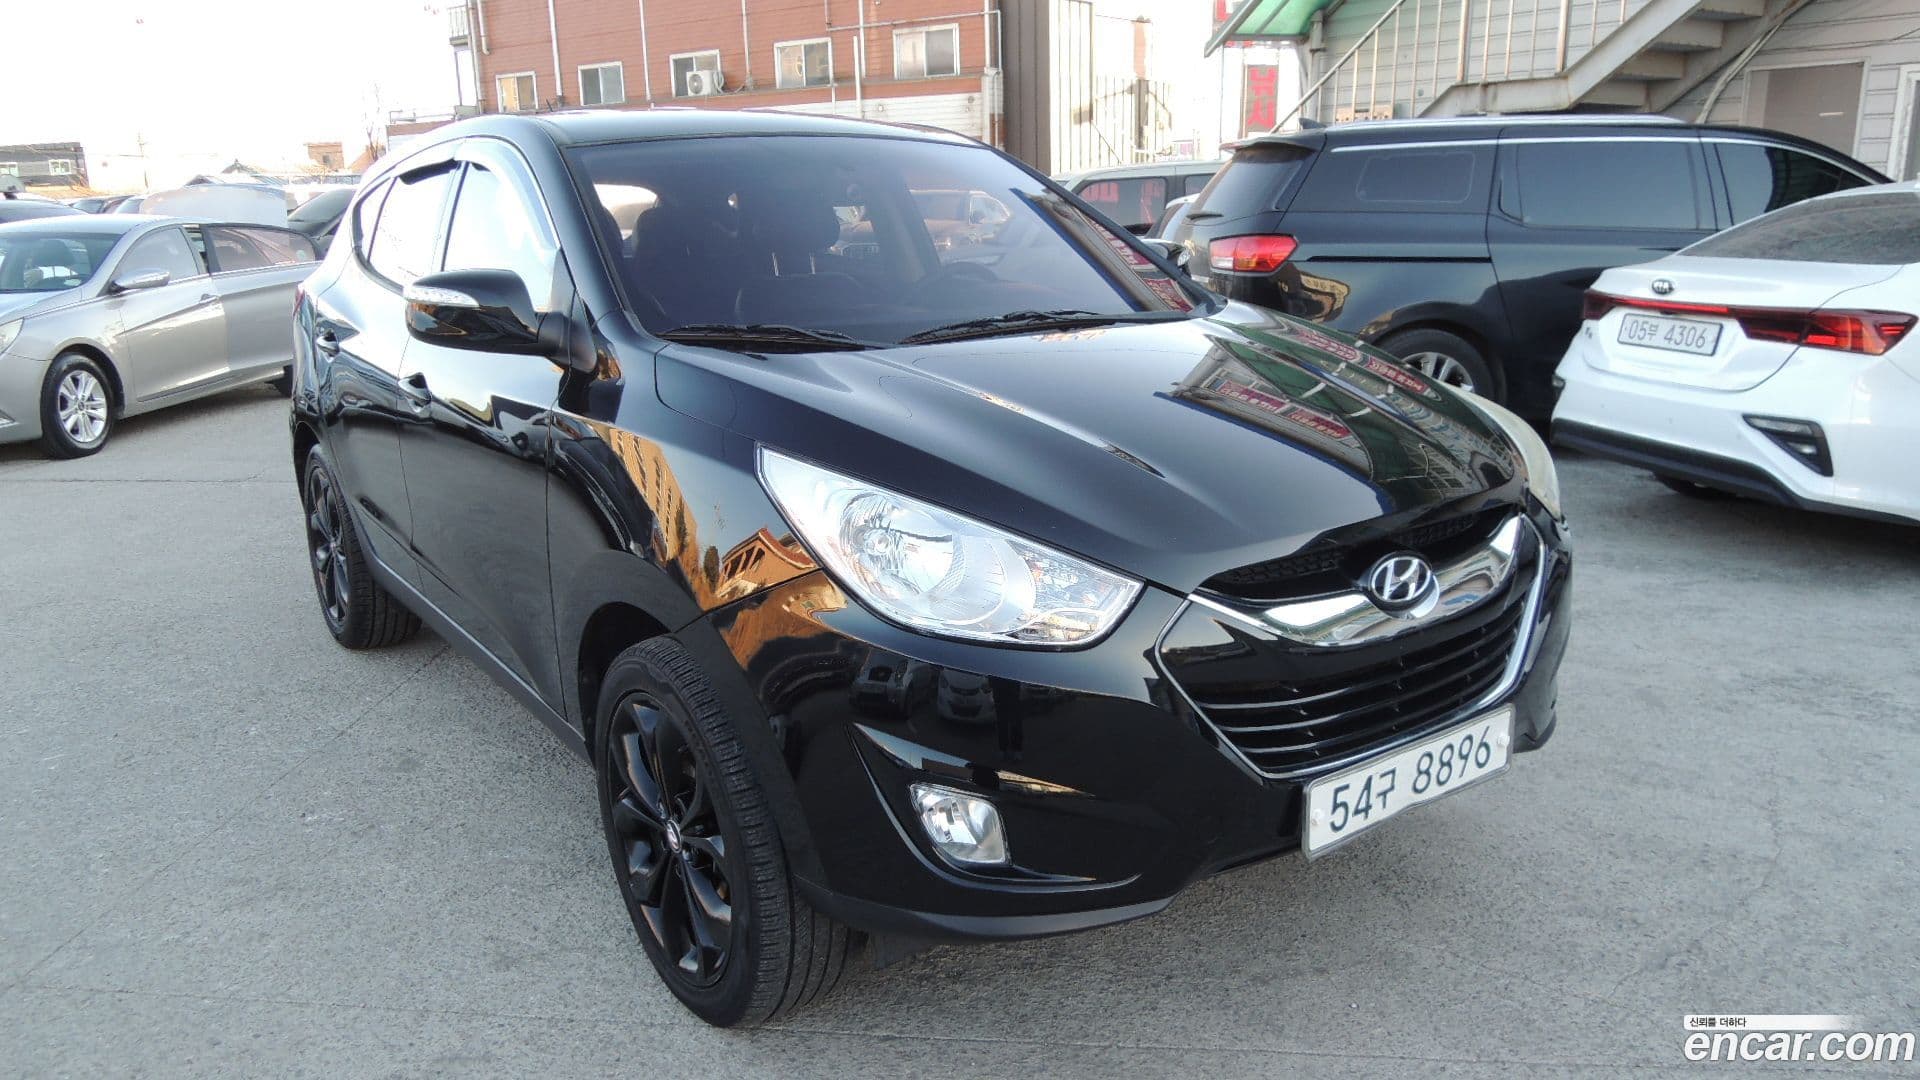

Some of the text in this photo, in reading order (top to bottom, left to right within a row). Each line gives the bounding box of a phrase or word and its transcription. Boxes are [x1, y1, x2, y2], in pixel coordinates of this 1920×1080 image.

[1663, 324, 1708, 349] 4306
[1330, 725, 1491, 833] 54구 8896
